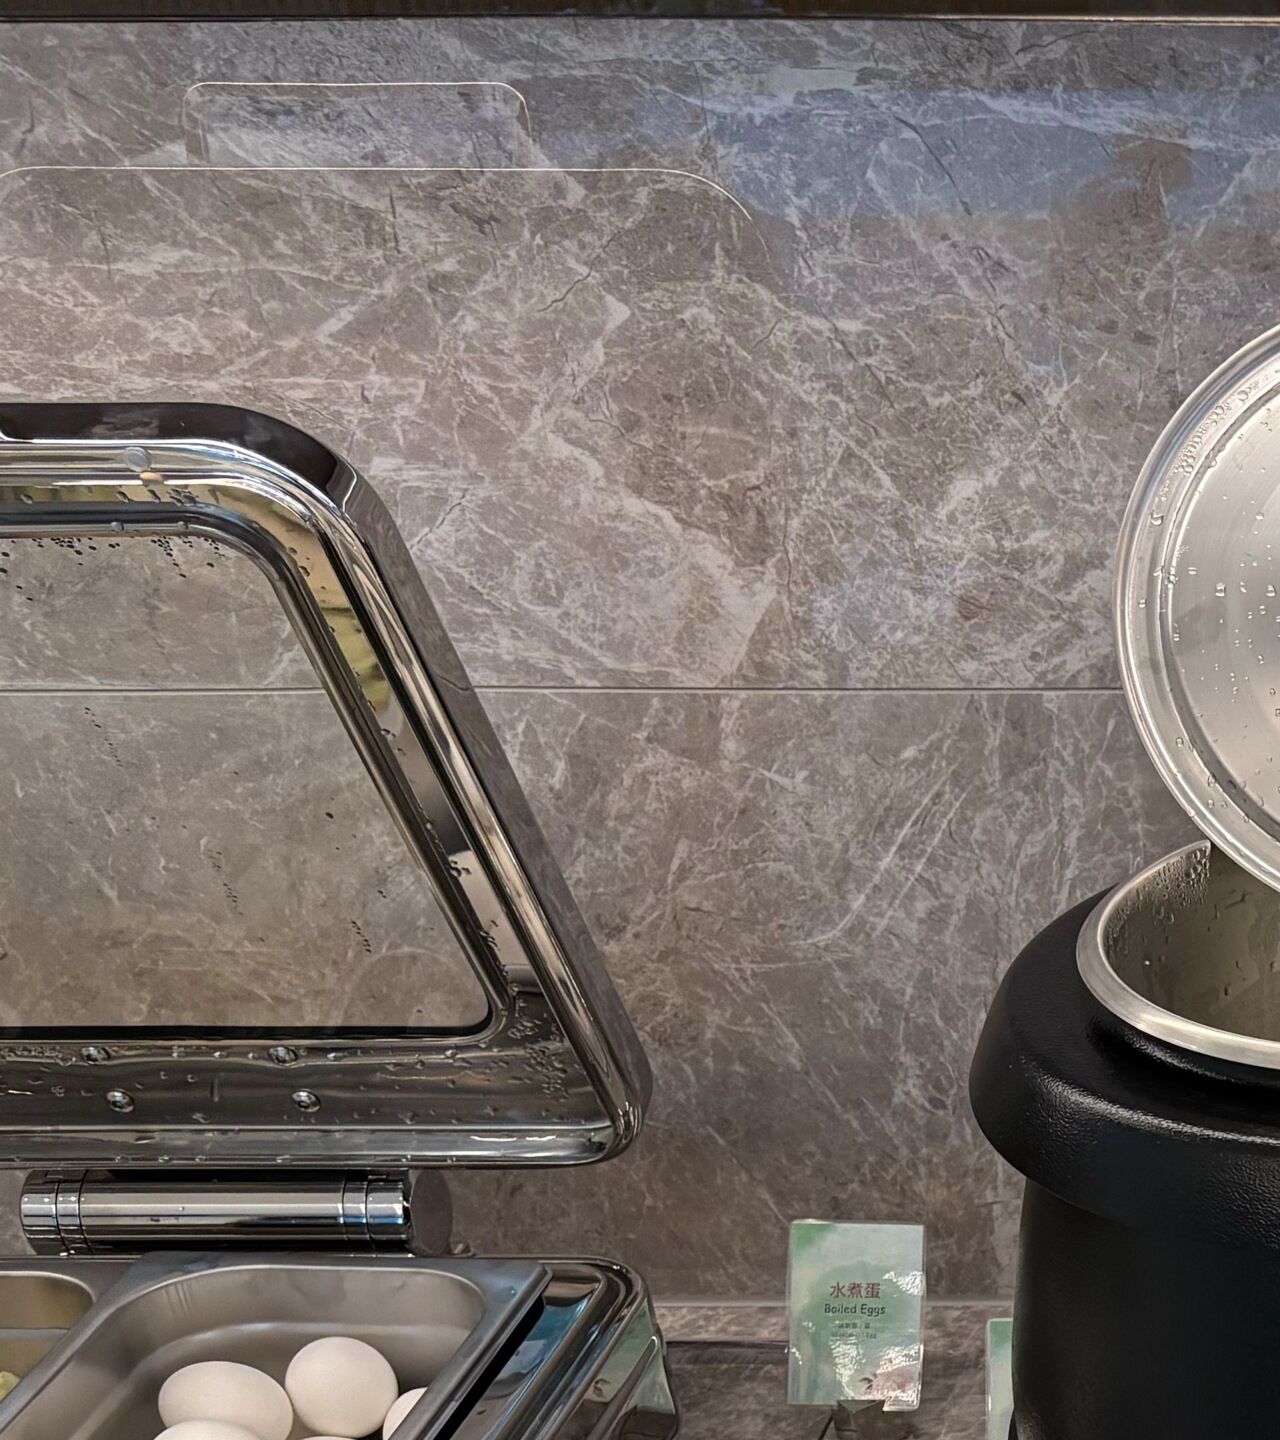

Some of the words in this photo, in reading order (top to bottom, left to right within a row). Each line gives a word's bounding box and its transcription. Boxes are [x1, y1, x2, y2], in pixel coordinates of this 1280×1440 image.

[829, 1281, 881, 1299] 水煮蛋
[824, 1303, 857, 1314] Boiled
[860, 1303, 886, 1317] Eggs
